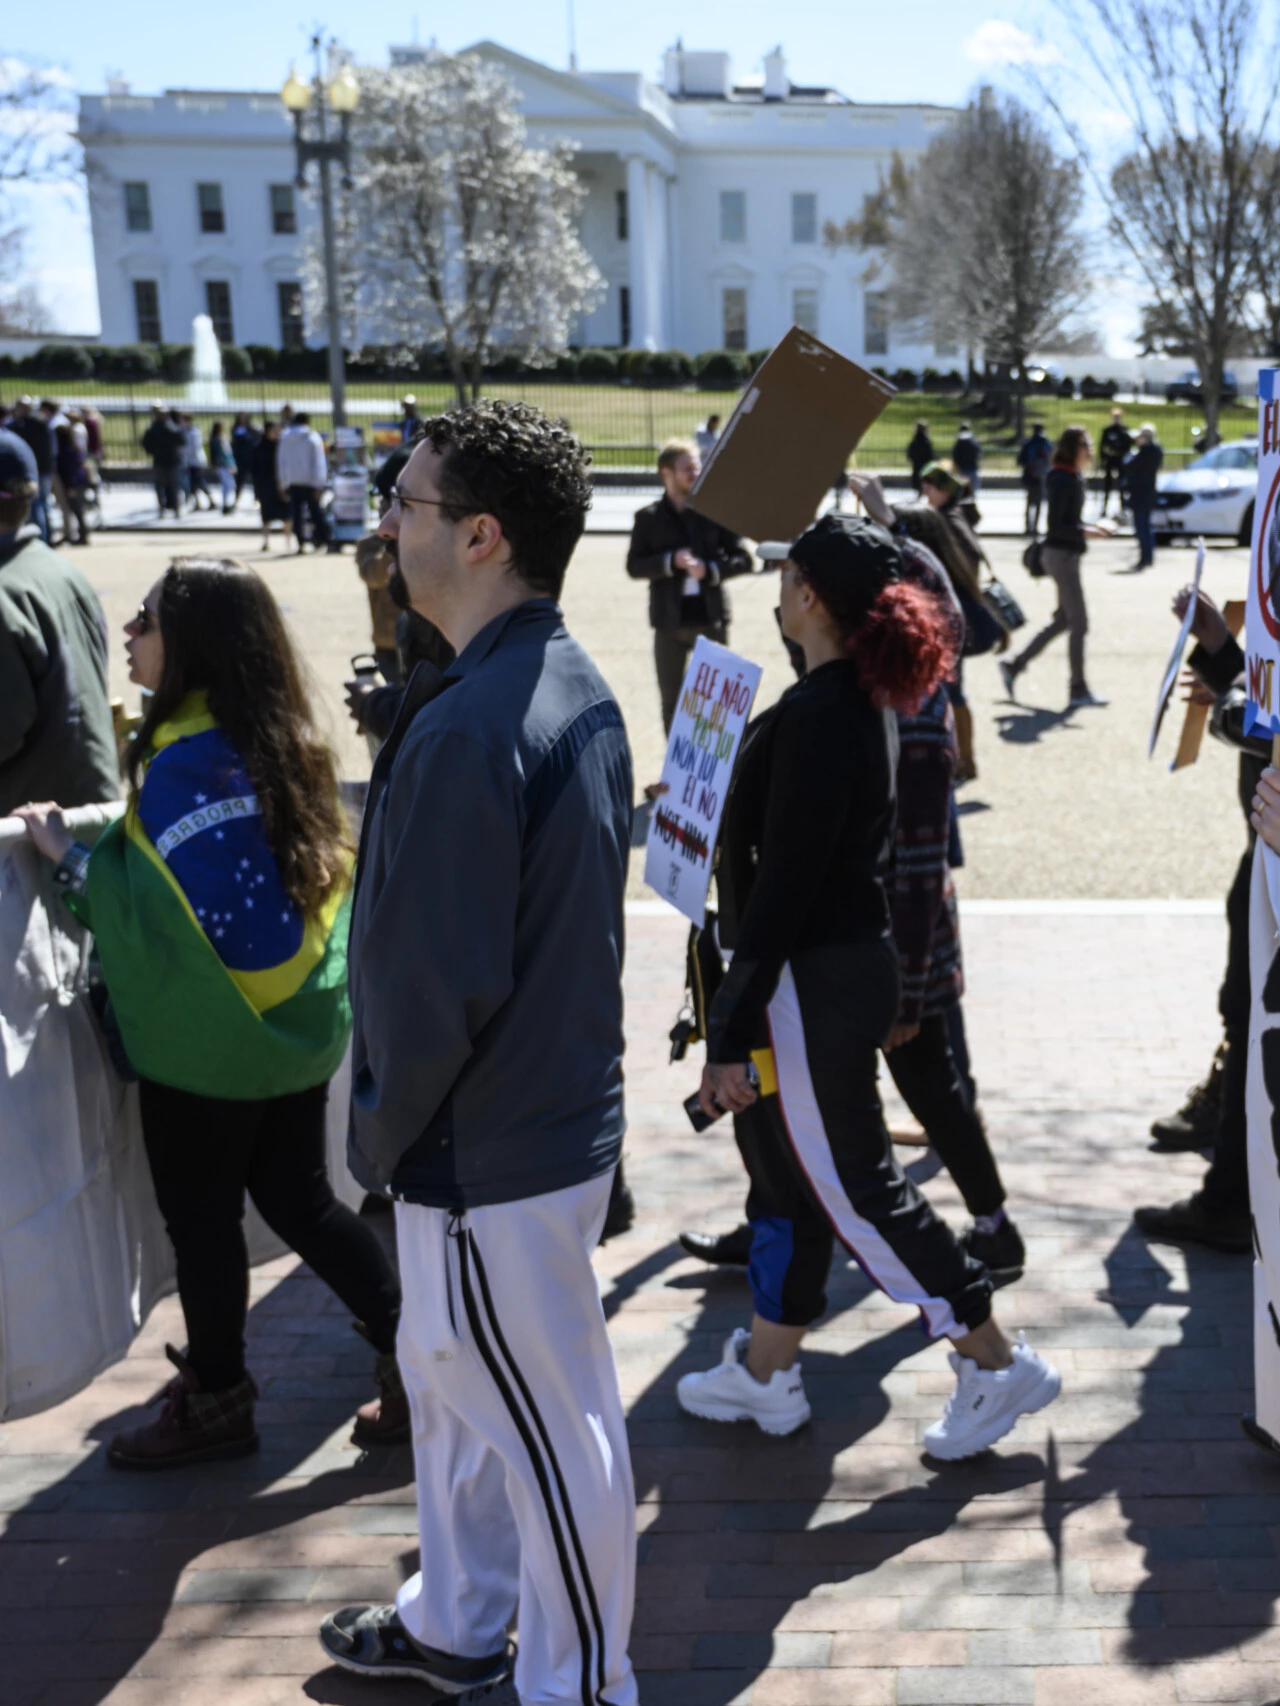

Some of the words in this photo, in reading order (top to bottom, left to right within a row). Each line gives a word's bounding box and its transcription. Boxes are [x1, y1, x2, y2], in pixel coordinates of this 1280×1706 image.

[693, 662, 720, 701] ELE
[719, 673, 751, 717] NÃO
[1249, 653, 1275, 716] NOT
[671, 735, 701, 773] NON
[654, 804, 682, 852] NOT
[697, 787, 717, 822] NO
